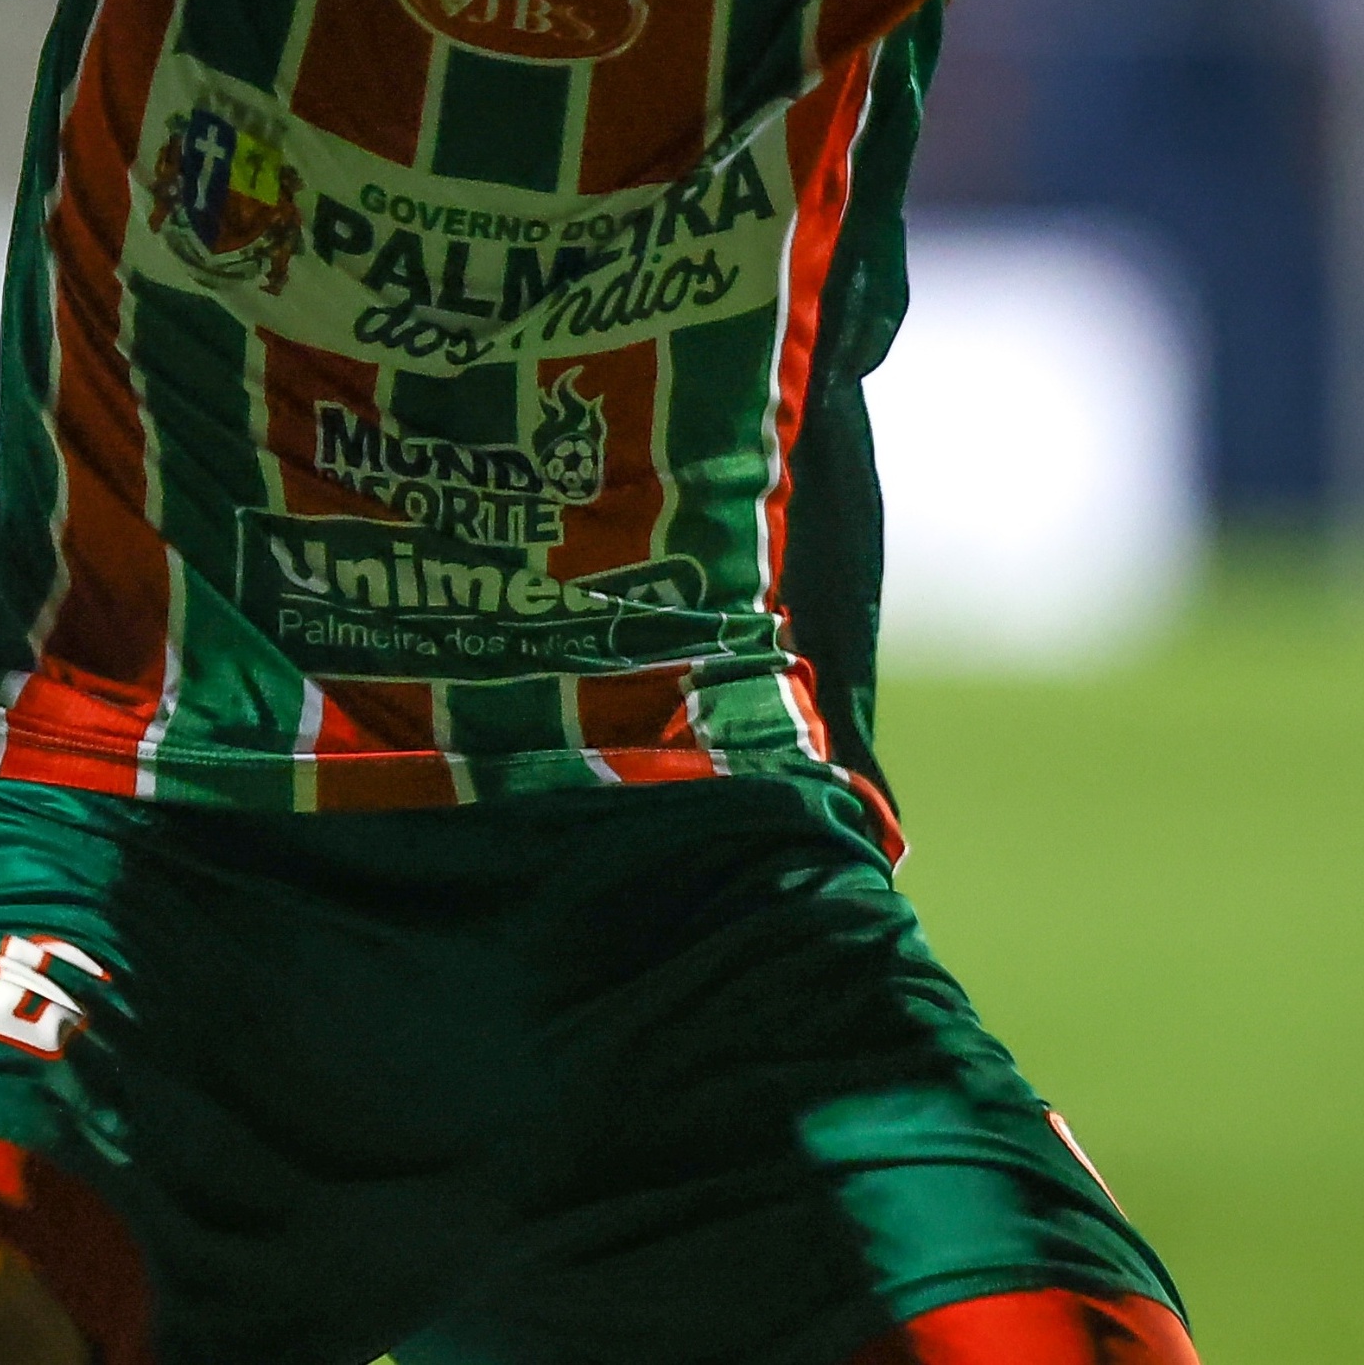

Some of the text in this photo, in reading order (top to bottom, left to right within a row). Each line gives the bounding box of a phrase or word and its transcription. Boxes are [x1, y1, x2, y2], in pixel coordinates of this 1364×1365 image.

[359, 183, 617, 243] GOVERNO DO
[353, 246, 740, 366] dos ndios
[277, 607, 437, 656] Palmeira
